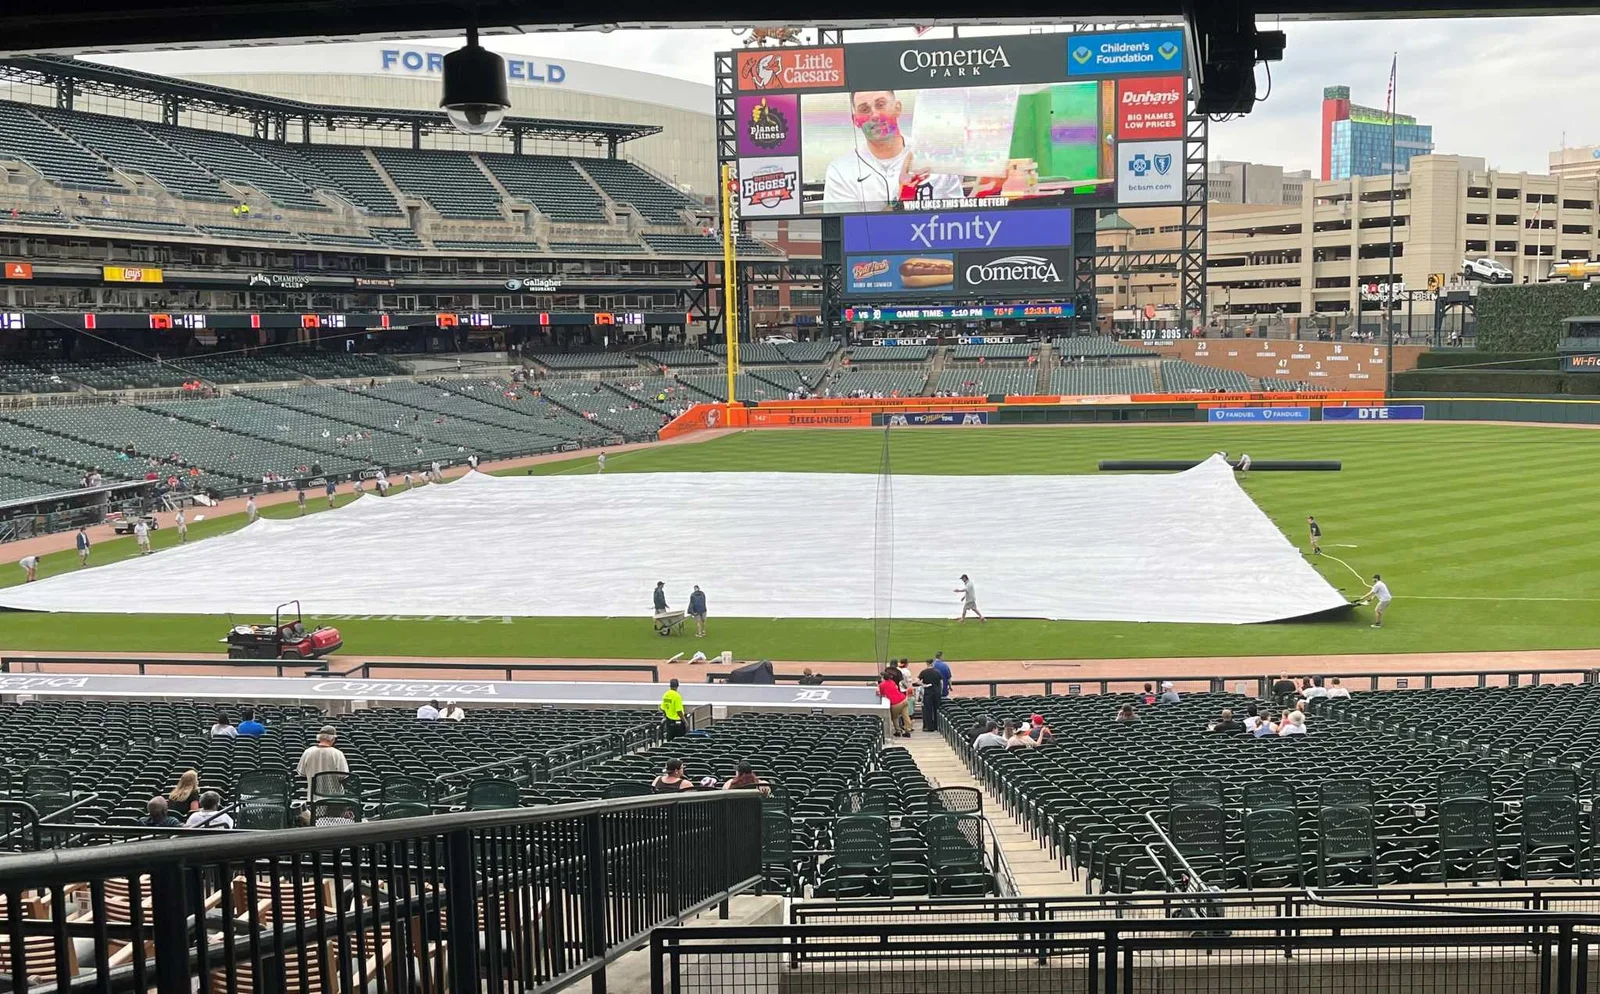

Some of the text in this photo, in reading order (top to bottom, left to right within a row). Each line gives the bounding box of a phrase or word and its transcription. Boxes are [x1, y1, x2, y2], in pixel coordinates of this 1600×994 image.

[1100, 42, 1150, 54] Children's
[794, 53, 833, 70] Little
[1096, 54, 1154, 65] Foundation
[381, 50, 566, 83] FOR ELD
[783, 68, 840, 84] Caesars
[930, 66, 981, 77] PARK
[1122, 89, 1180, 104] Dunham's
[1144, 112, 1174, 120] NAMES
[1145, 120, 1176, 128] PRICES
[750, 125, 779, 135] planet
[755, 132, 785, 140] fitness
[903, 200, 920, 210] WHO
[921, 199, 941, 209] LIKES
[942, 198, 959, 208] THIS
[978, 197, 1009, 207] BETTER?
[910, 214, 1002, 248] xfinity
[273, 275, 309, 283] CHAMPIONS
[523, 278, 561, 287] Gallagher
[858, 311, 869, 319] VS
[896, 310, 919, 318] GAME
[922, 309, 944, 317] TIME:
[1024, 307, 1046, 315] 12:31
[1048, 306, 1062, 314] PM
[1141, 328, 1181, 339] 507 3095
[872, 338, 928, 346] CHEVROLET
[958, 337, 1014, 345] CHEVROLET
[1197, 342, 1207, 350] 23
[1264, 342, 1269, 350] 5
[1299, 344, 1304, 352] 2
[1374, 348, 1379, 356] 6
[1278, 360, 1287, 368] 47
[1316, 362, 1321, 370] 3
[1573, 357, 1595, 366] Wi-Fi
[1357, 363, 1361, 371] 1
[1358, 409, 1388, 419] DTE
